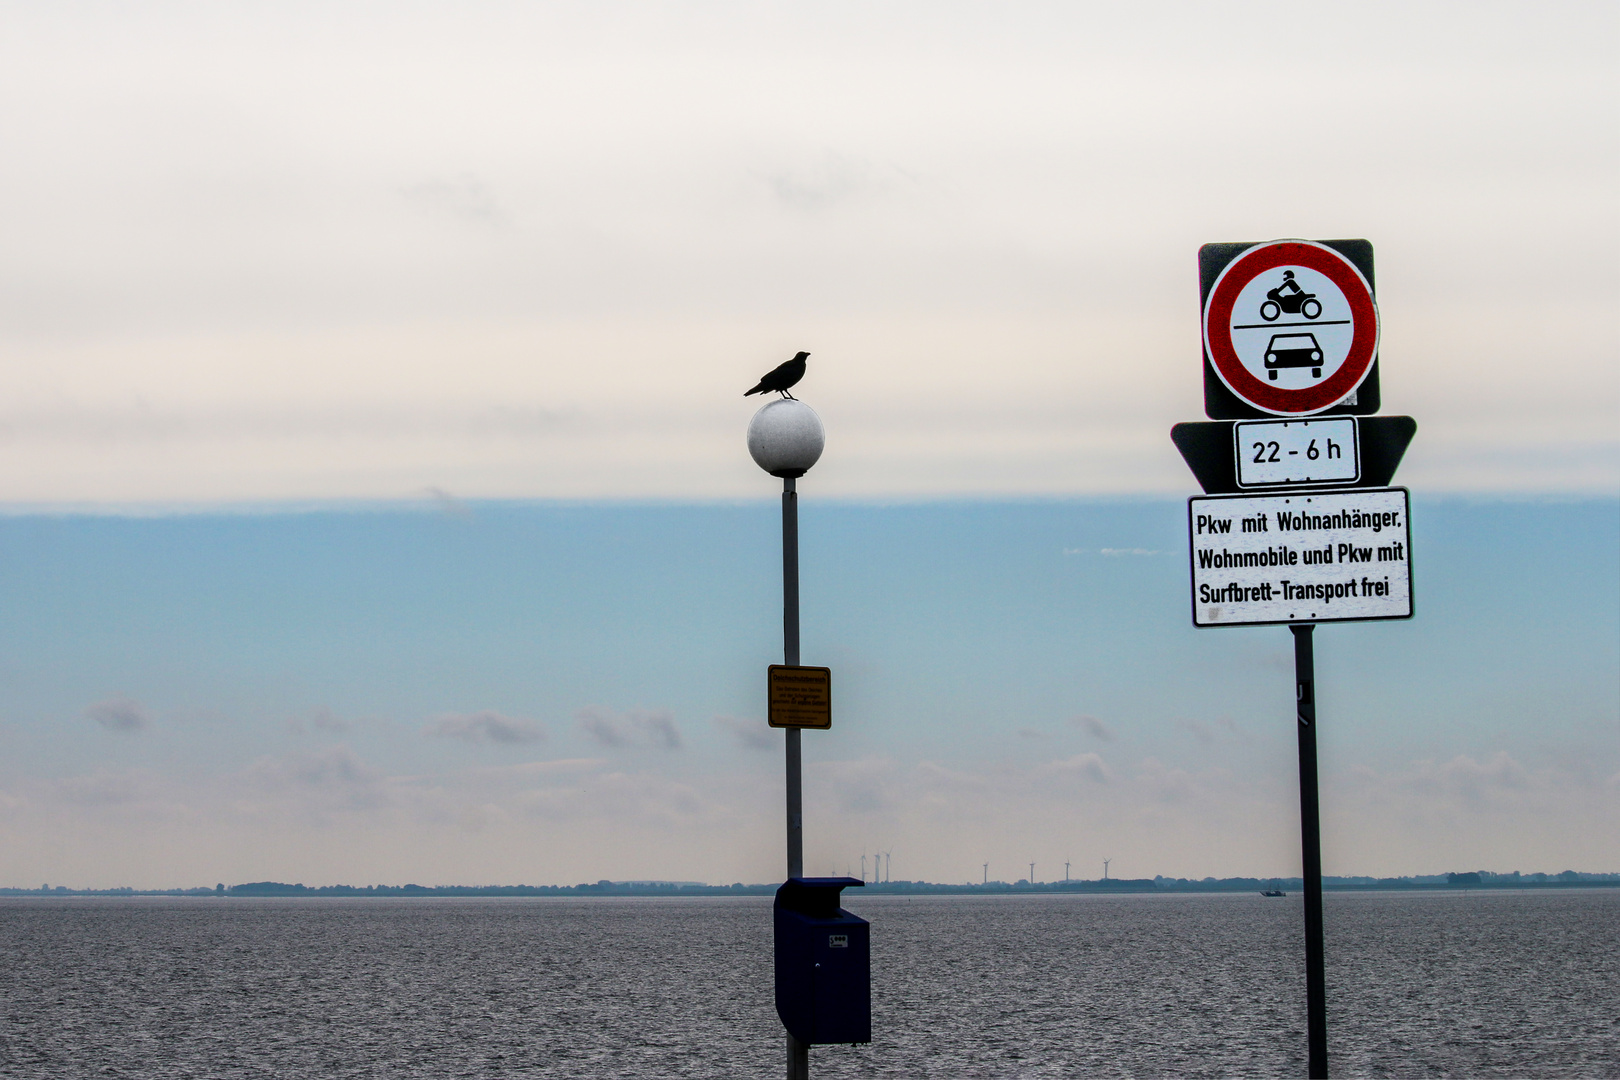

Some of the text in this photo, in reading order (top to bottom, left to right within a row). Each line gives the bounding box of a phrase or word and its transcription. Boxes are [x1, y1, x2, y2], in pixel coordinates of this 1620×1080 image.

[1253, 441, 1280, 463] 22
[1307, 439, 1319, 460] 6
[1327, 438, 1341, 459] h
[1197, 509, 1402, 534] Pkw mit Wohnanhänger,
[1198, 541, 1404, 569] Wohnmobile und Pkw mit
[1200, 576, 1389, 604] Surfbrett-Transport frei
